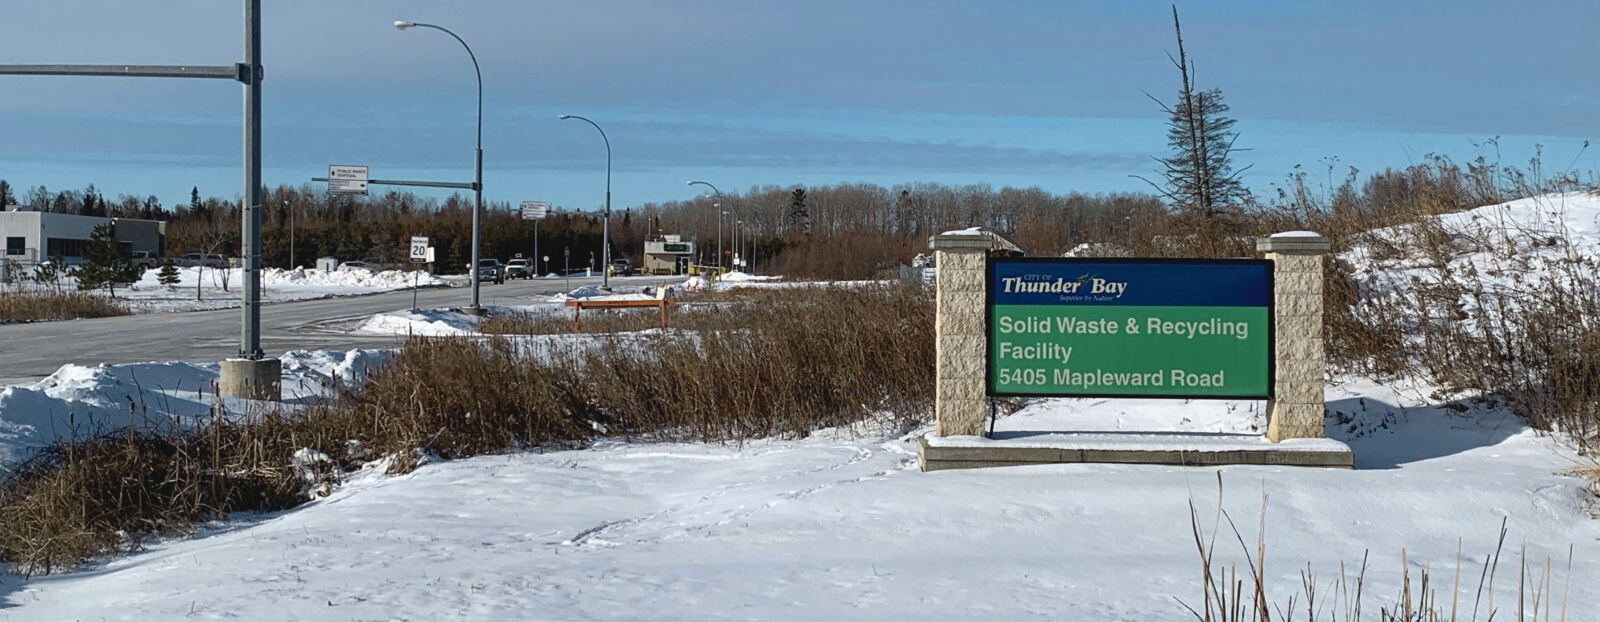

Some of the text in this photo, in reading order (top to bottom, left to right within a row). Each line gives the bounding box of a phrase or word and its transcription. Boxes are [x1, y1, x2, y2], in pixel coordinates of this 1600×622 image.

[413, 245, 425, 255] 20
[1002, 276, 1127, 298] Thunder Bay
[1060, 295, 1083, 303] Superior
[1085, 295, 1092, 303] by
[999, 316, 1249, 340] Solid Waste & Recycling
[999, 341, 1073, 364] Facility
[999, 368, 1225, 389] 5405 Mapleward Road
